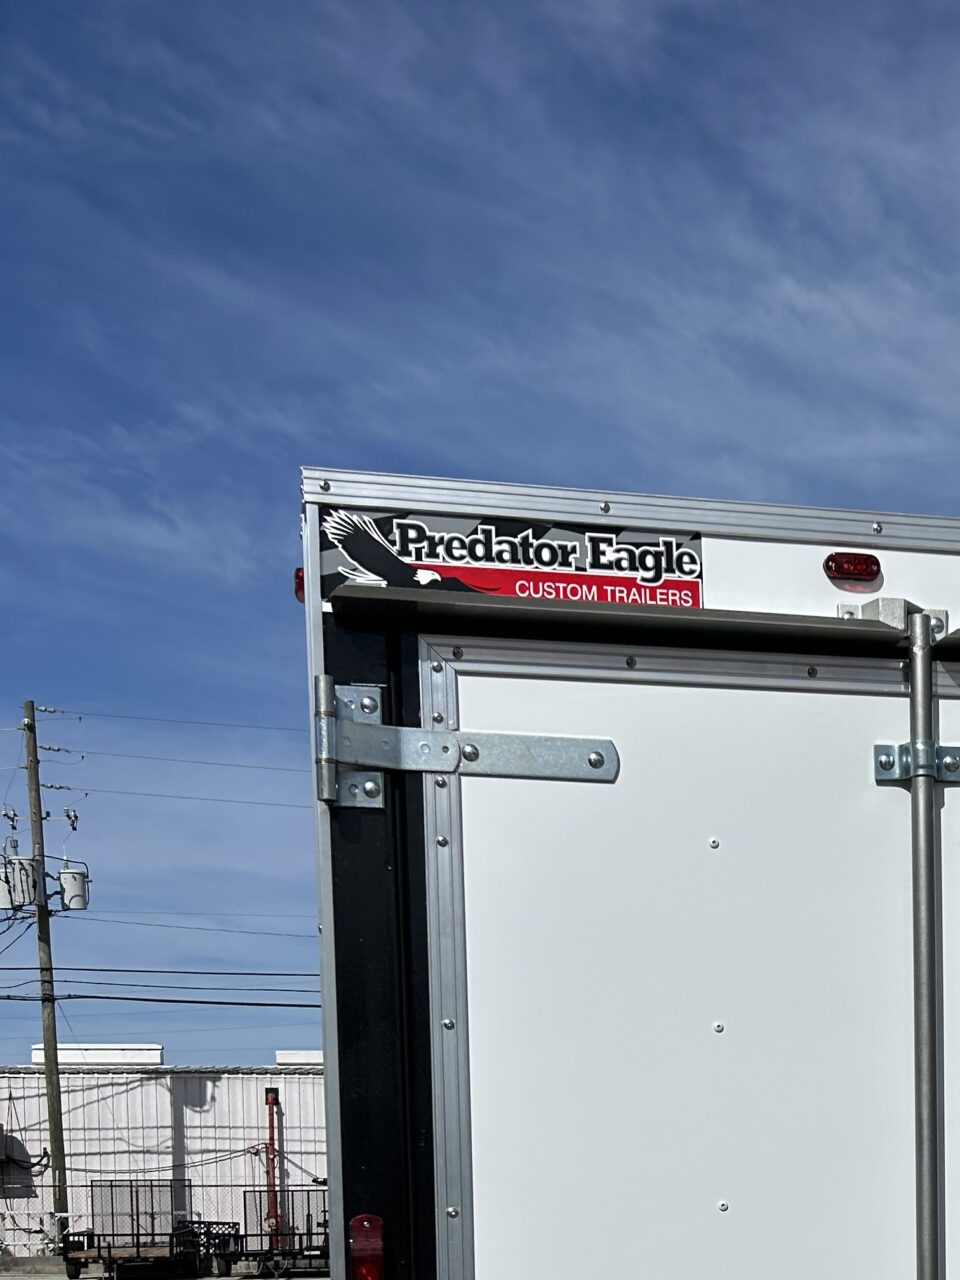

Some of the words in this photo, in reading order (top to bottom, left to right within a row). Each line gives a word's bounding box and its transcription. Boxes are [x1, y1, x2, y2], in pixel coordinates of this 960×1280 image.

[393, 519, 580, 569] Predator
[585, 532, 701, 585] Eagle
[515, 580, 597, 600] CUSTOM
[603, 586, 692, 606] TRAILERS
